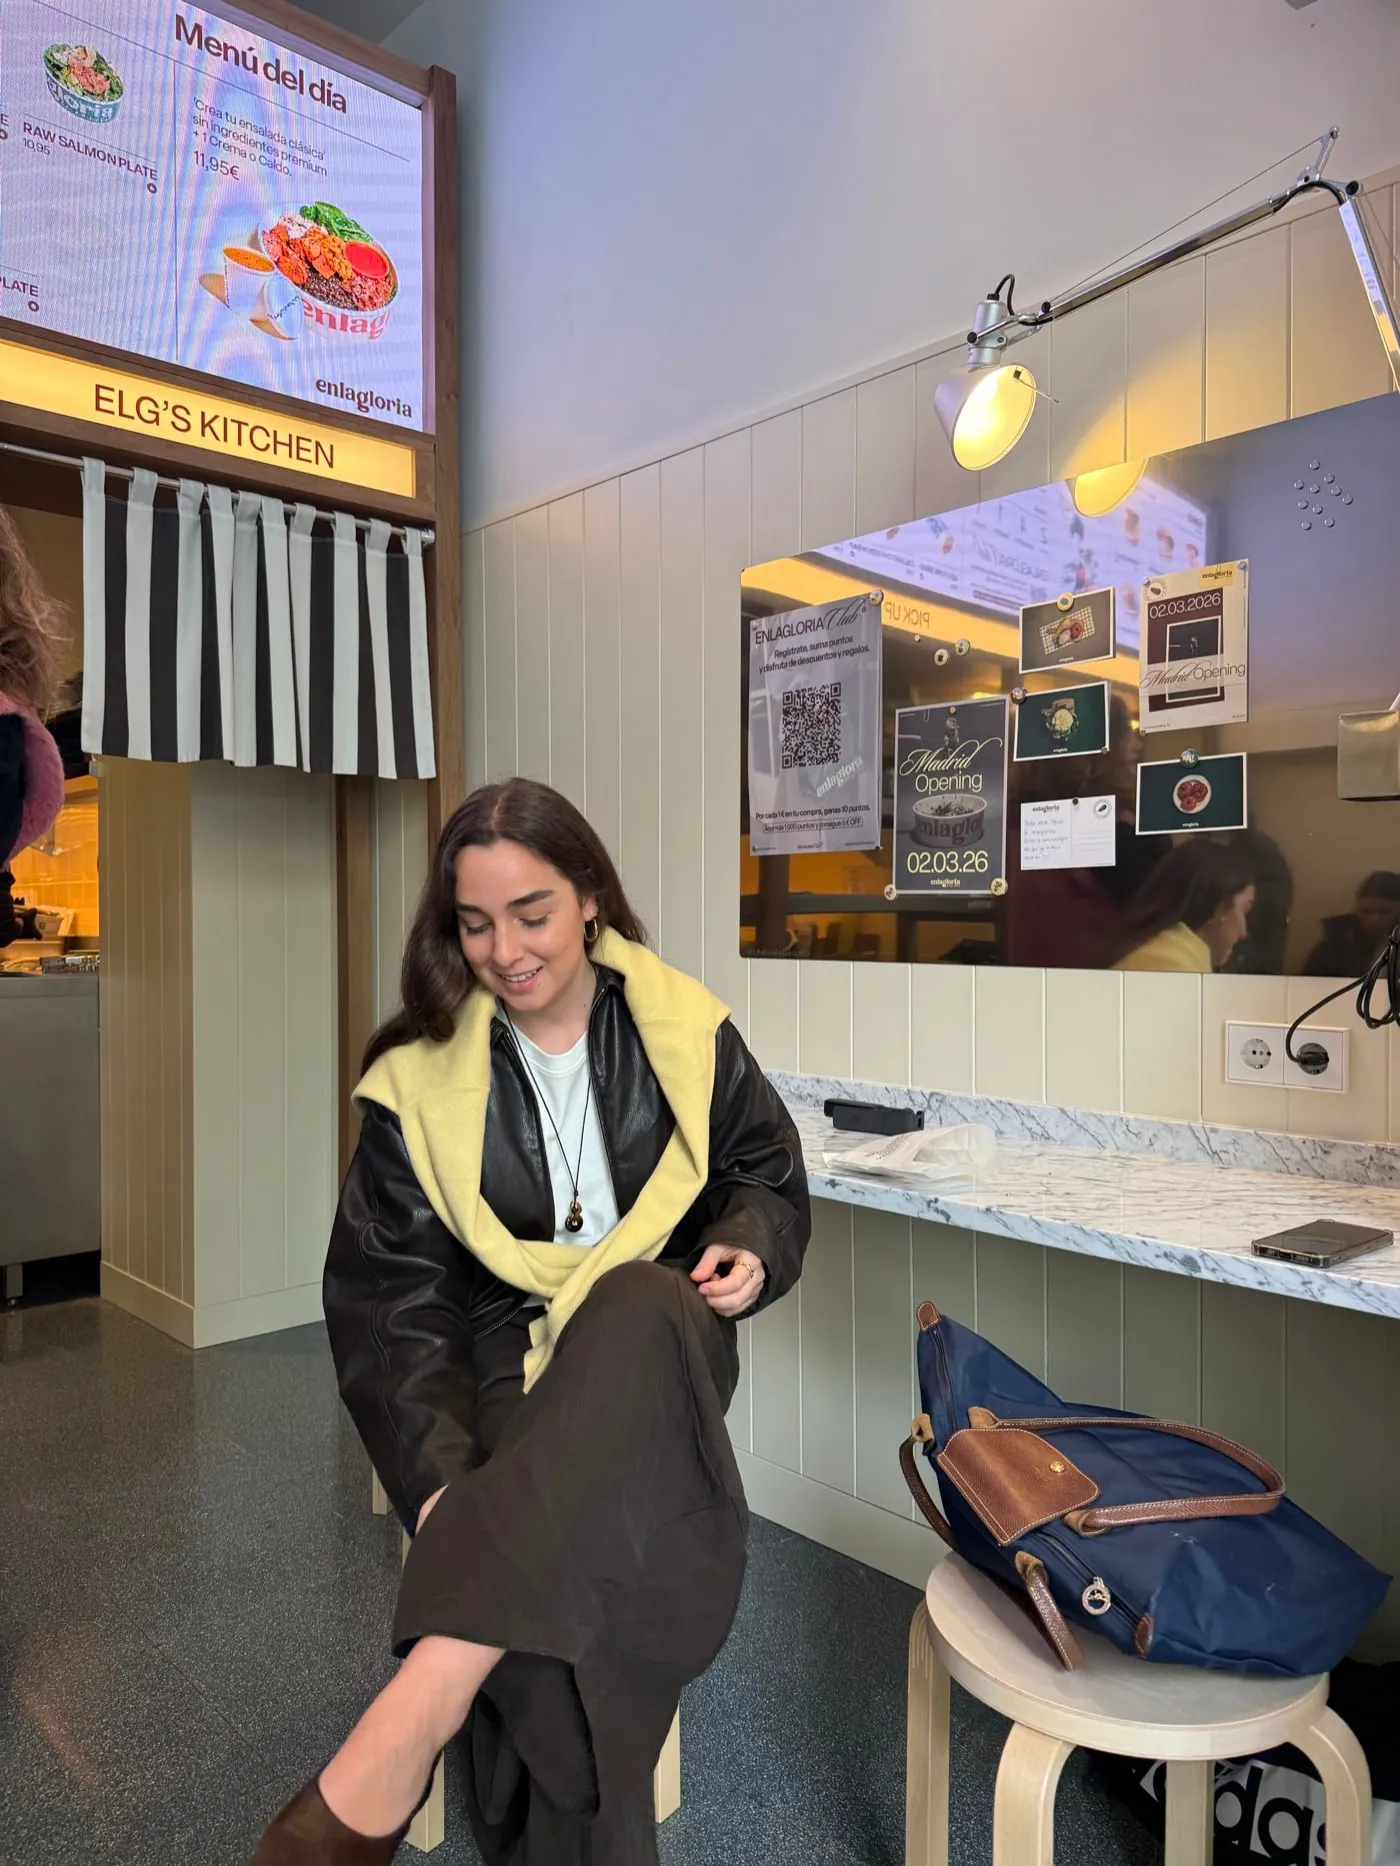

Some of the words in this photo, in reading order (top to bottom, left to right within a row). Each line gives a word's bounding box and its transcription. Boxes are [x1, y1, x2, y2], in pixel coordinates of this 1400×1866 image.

[175, 13, 258, 75] Menú
[263, 58, 304, 95] del
[308, 79, 347, 114] día
[225, 111, 236, 125] tu
[239, 118, 287, 145] ensalada
[22, 137, 51, 156] 10,95
[23, 121, 56, 144] RAW
[58, 135, 117, 166] SALMON
[118, 157, 158, 181] PLATE
[192, 115, 209, 129] sin
[210, 121, 280, 158] ingredientes
[280, 150, 328, 177] premium
[209, 135, 247, 159] Crema
[248, 151, 257, 162] o
[258, 155, 292, 177] Caldo.
[193, 150, 240, 181] 11,95€
[0, 274, 39, 298] LATE
[315, 377, 413, 419] enlagloria
[94, 383, 192, 433] ELG'S
[200, 414, 335, 470] KITCHEN
[1149, 592, 1221, 619] 02.03.2026
[755, 617, 825, 645] ENLAGLORIA
[809, 641, 828, 652] suma
[828, 635, 854, 649] puntos
[763, 660, 788, 673] disfruta
[788, 659, 797, 668] de
[797, 651, 837, 666] descuentos
[1140, 660, 1212, 689] Madrid
[1193, 662, 1246, 682] Opening
[899, 736, 1003, 777] Madrid
[816, 755, 864, 798] enlagloria
[915, 770, 983, 796] Opening
[755, 811, 765, 820] Por
[906, 849, 989, 874] 02.03.26
